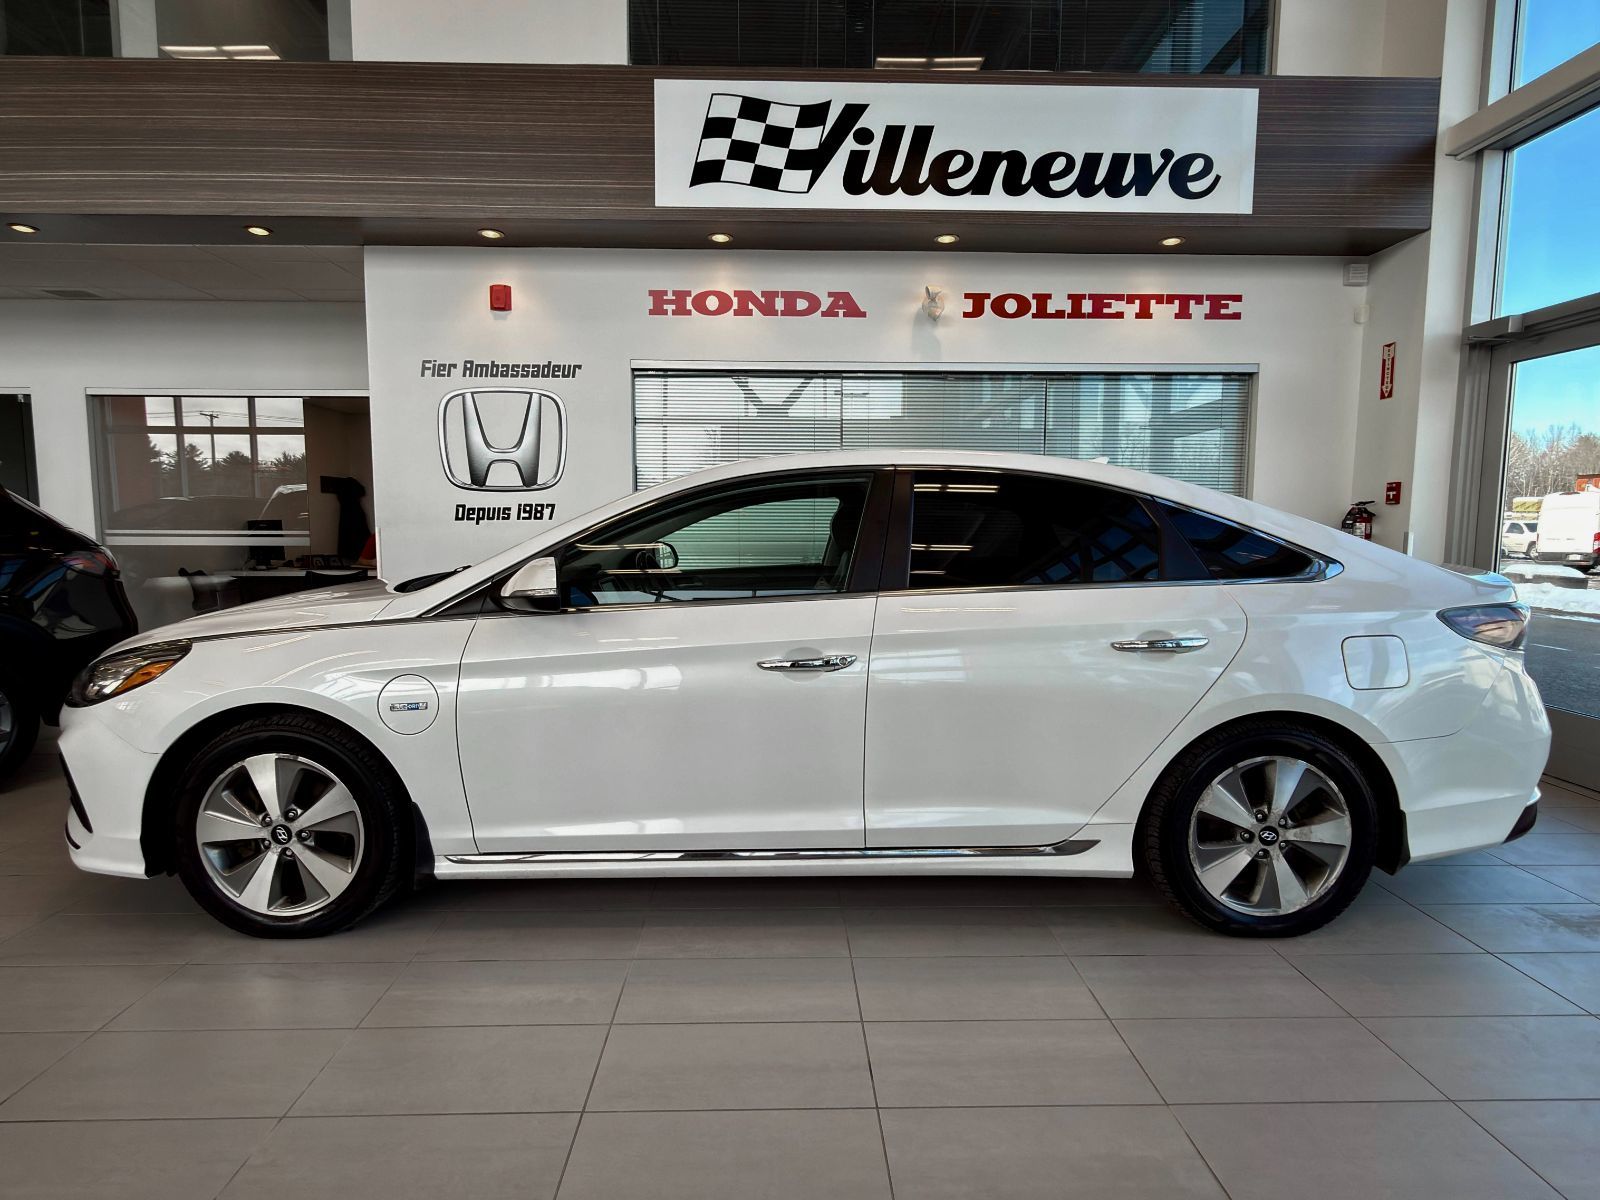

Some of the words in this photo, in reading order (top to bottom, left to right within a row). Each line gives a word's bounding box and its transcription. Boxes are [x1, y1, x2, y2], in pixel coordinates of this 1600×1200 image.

[806, 103, 1222, 200] Villeneuve
[648, 289, 867, 318] HONDA
[962, 292, 1243, 320] JOLIETTE
[420, 359, 457, 378] Fier
[462, 360, 582, 379] Ambassadeur
[455, 503, 511, 526] Depuis
[516, 503, 556, 521] 1987
